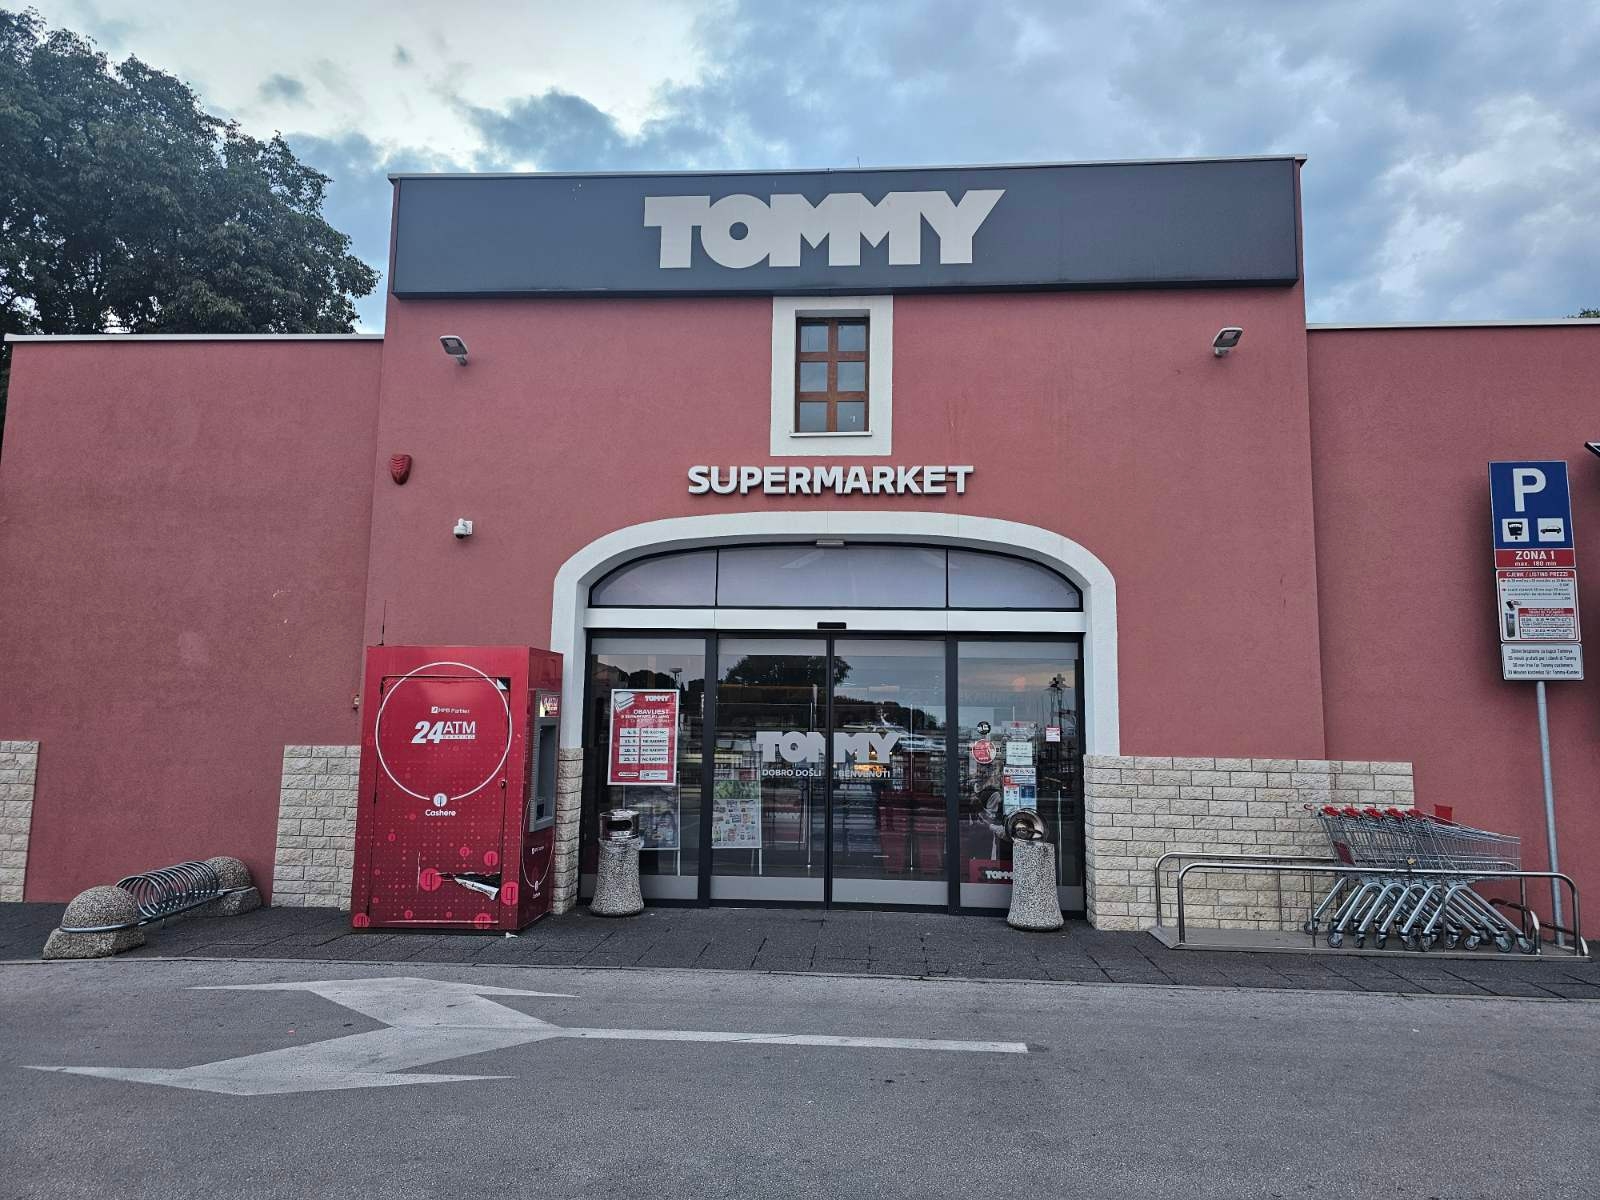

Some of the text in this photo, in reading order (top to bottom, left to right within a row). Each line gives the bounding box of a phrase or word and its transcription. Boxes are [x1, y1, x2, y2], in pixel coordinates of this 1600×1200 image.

[643, 189, 1006, 269] TOMMY
[687, 465, 975, 496] SUPERMARKET
[1513, 468, 1547, 512] P
[1515, 550, 1556, 560] ZONA 1
[443, 721, 476, 734] ATM
[762, 769, 794, 777] DOBRO
[795, 767, 822, 777] DOŠLI
[838, 770, 891, 778] BENVENUTI
[425, 809, 457, 817] Cashere
